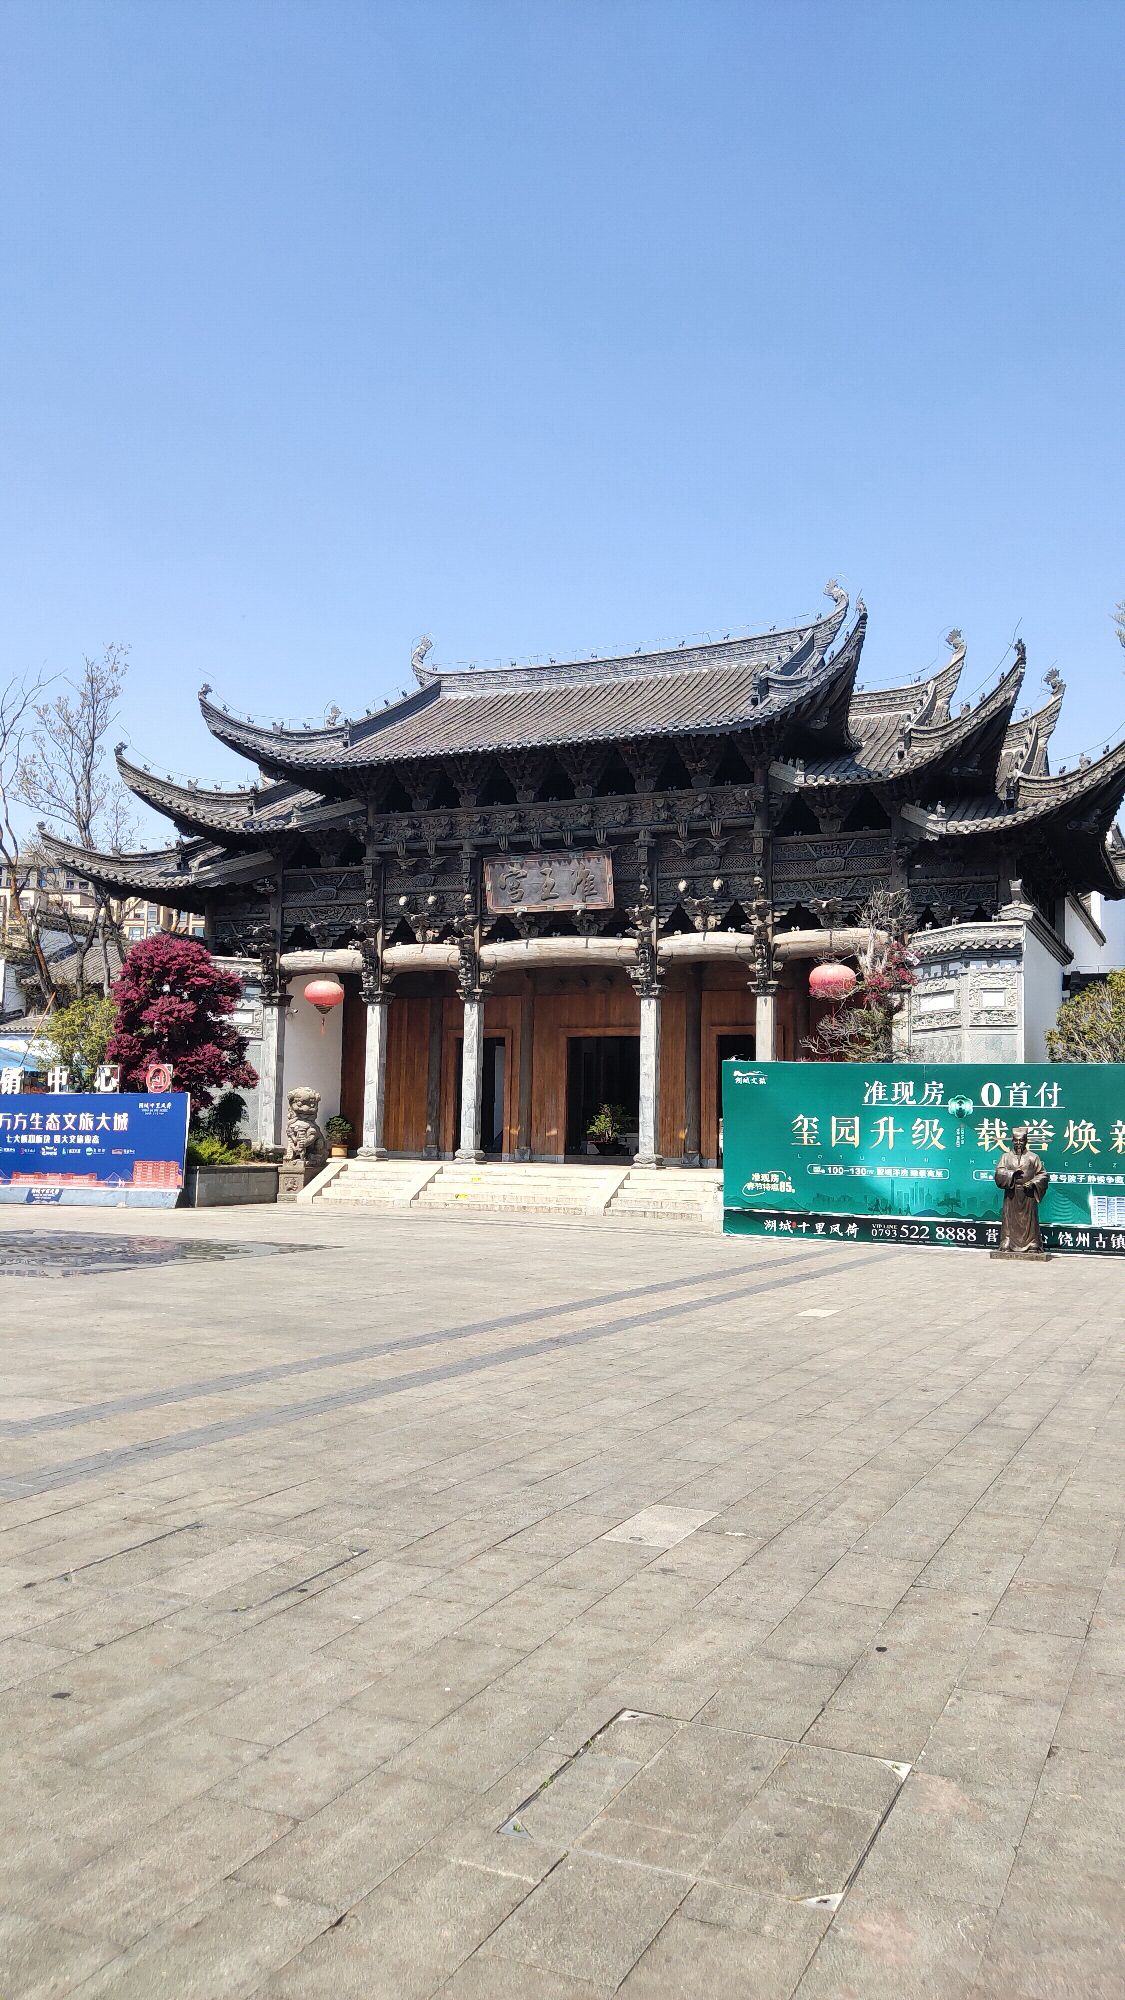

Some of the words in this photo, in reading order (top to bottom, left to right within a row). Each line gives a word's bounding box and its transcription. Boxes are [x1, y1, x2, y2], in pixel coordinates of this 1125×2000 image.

[863, 1080, 945, 1106] 准现房
[980, 1081, 1063, 1107] 0首付
[791, 1114, 946, 1150] 玺园升级
[871, 1229, 897, 1238] 0793
[900, 1225, 929, 1239] 522
[935, 1226, 977, 1242] 8888
[1058, 1231, 1125, 1249] 饶州古镇
